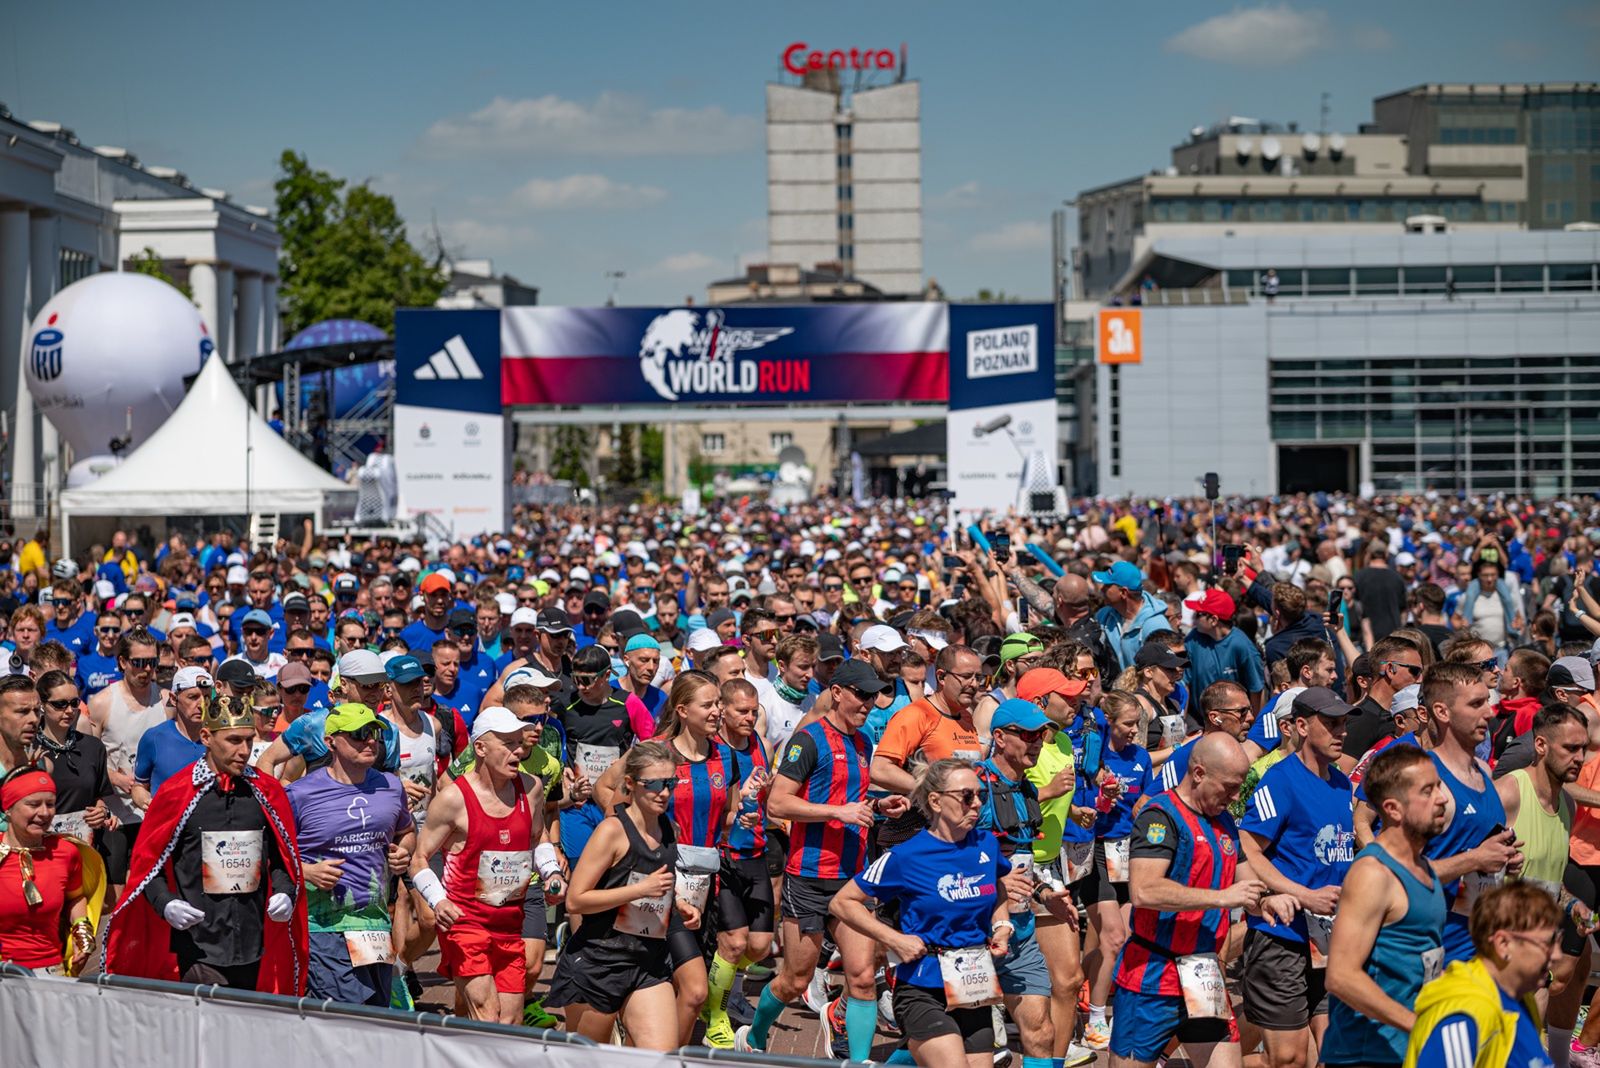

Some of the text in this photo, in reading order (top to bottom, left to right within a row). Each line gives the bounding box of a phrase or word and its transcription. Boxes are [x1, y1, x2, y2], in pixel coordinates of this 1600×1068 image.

[973, 331, 1030, 351] POLAND
[334, 831, 386, 845] PARKRUN
[220, 857, 251, 869] 16543
[493, 875, 520, 885] 11574
[361, 932, 386, 943] 11510
[961, 972, 989, 986] 10556
